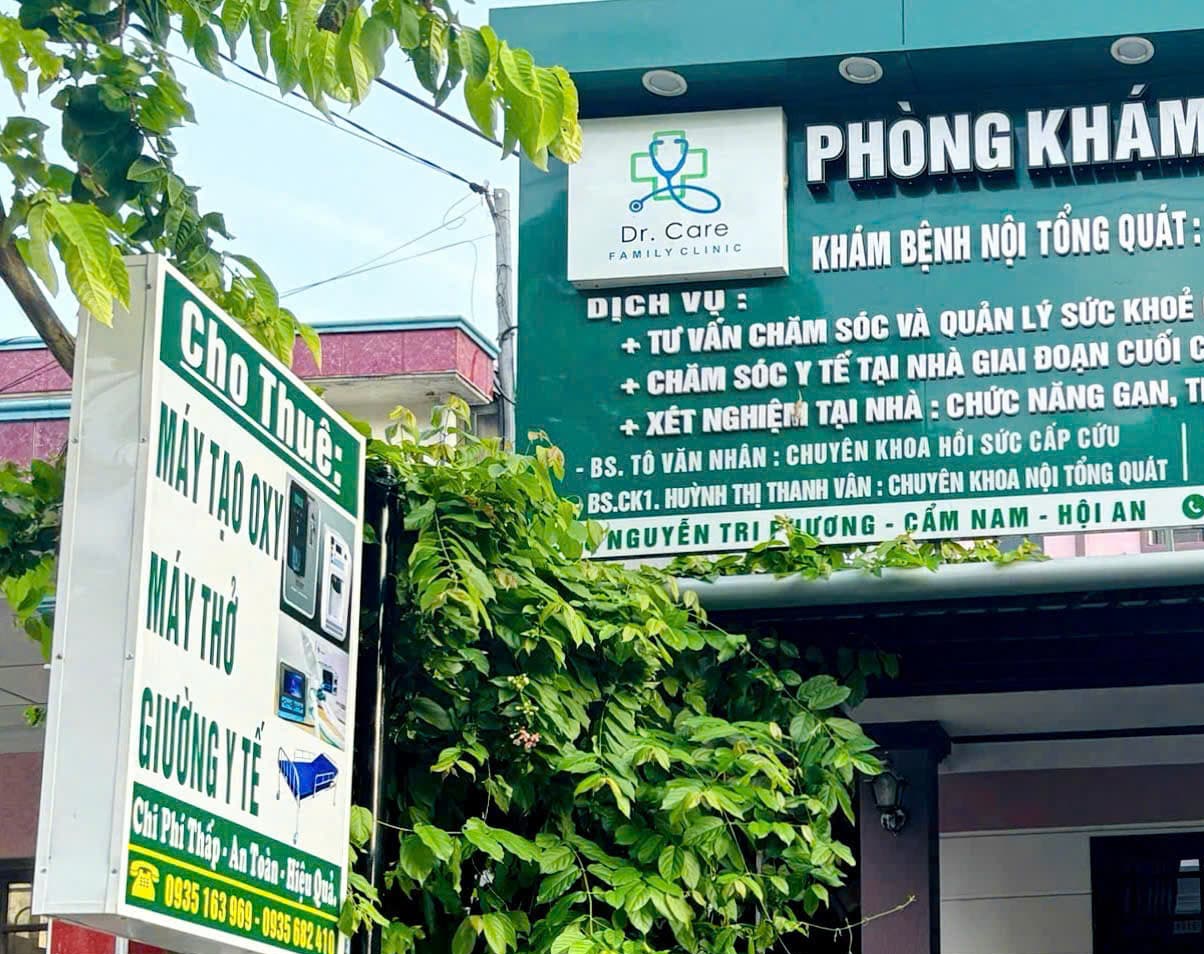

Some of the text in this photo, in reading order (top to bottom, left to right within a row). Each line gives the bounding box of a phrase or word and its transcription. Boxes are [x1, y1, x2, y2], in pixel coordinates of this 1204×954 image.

[806, 102, 1013, 182] PHÒNG
[609, 244, 742, 260] FAMILY CLINIC
[621, 222, 728, 243] Dr. Care
[812, 225, 892, 271] KHÁM
[900, 220, 970, 272] BỆNH
[981, 217, 1027, 266] NỘI
[1036, 203, 1109, 256] TỔNG
[587, 290, 725, 321] DỊCH VỤ
[648, 326, 684, 355] TƯ
[687, 317, 741, 353] VẤN
[749, 313, 826, 347] CHĂM
[835, 306, 888, 340] SÓC
[897, 306, 930, 339] VÀ
[940, 298, 1014, 336] QUẢN
[1021, 297, 1051, 329] LÝ
[1061, 295, 1115, 327] SỨC
[1124, 286, 1194, 323] KHOẺ
[181, 300, 248, 406] Cho
[646, 404, 696, 437] XÉT
[703, 397, 808, 435] NGHIỆM
[816, 398, 858, 430] TẠI
[866, 391, 921, 422] NHÀ
[946, 385, 1019, 420] CHỨC
[1027, 380, 1105, 415] NĂNG
[1113, 377, 1177, 409] GAN,
[156, 401, 284, 561] MÁY TẠO OXY
[587, 455, 1168, 514] BS.CK1. HUỲNH THỊ THANH VÂN CHUYÊN KHOA NỘI TỔNG QUÁT
[591, 421, 1119, 479] BS. TÔ VĂN NHÂN CHUYÊN KHOA HỒI SỨC CẤP CỨU
[607, 518, 709, 550] NGUYỄN
[720, 521, 759, 543] TRI
[905, 502, 960, 532] CẨM
[971, 505, 1028, 529] NAM
[1058, 502, 1102, 528] HỘI
[1112, 500, 1146, 521] AN
[147, 549, 239, 675] MÁY THỞ
[138, 686, 265, 817] GIƯỜNG Y TẾ
[133, 796, 312, 903] Chi Phí Thấp An Toàn Hiệu
[164, 873, 199, 915] 0935
[203, 886, 226, 924] 163
[228, 892, 253, 932] 969
[262, 906, 292, 944] 0935
[292, 916, 314, 951] 682
